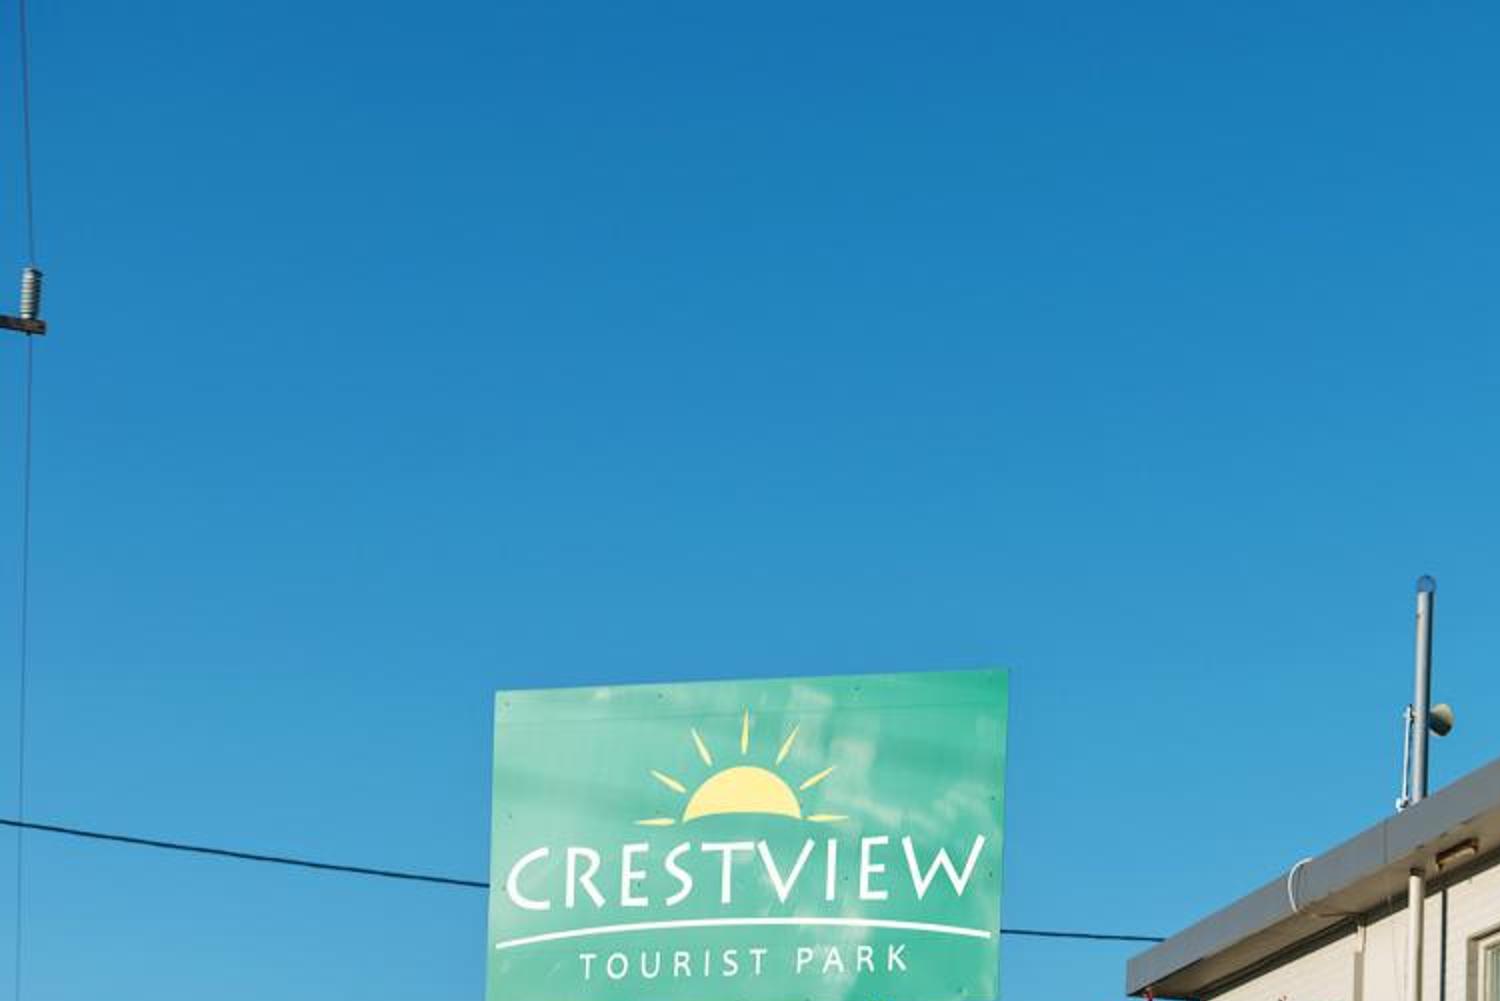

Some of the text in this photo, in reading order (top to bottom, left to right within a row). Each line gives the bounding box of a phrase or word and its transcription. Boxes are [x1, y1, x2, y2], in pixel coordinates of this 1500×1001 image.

[505, 835, 985, 911] CRESTVIEW
[580, 944, 908, 980] TOURIST PARK
